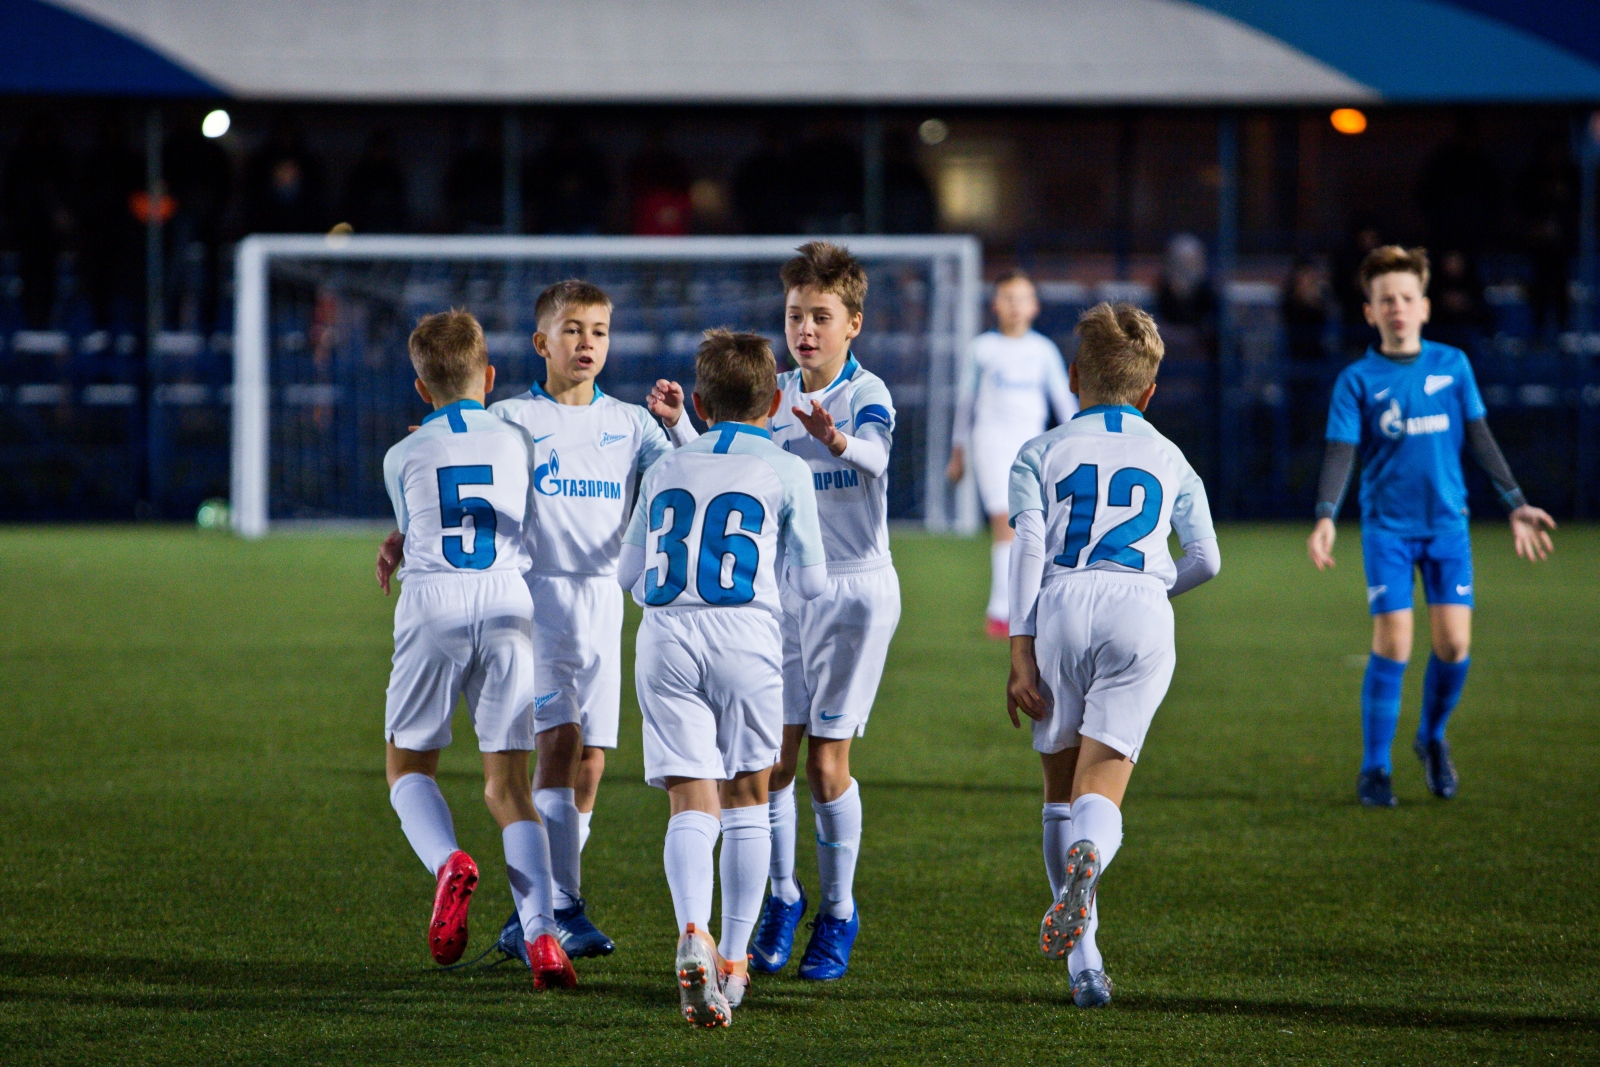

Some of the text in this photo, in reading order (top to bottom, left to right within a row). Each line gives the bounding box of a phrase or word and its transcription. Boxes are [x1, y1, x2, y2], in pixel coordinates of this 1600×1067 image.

[436, 465, 497, 570] 5
[563, 479, 621, 499] ГАЗПРОМ
[813, 468, 859, 491] ПРОМ
[1053, 463, 1163, 571] 12
[644, 488, 765, 606] 36
